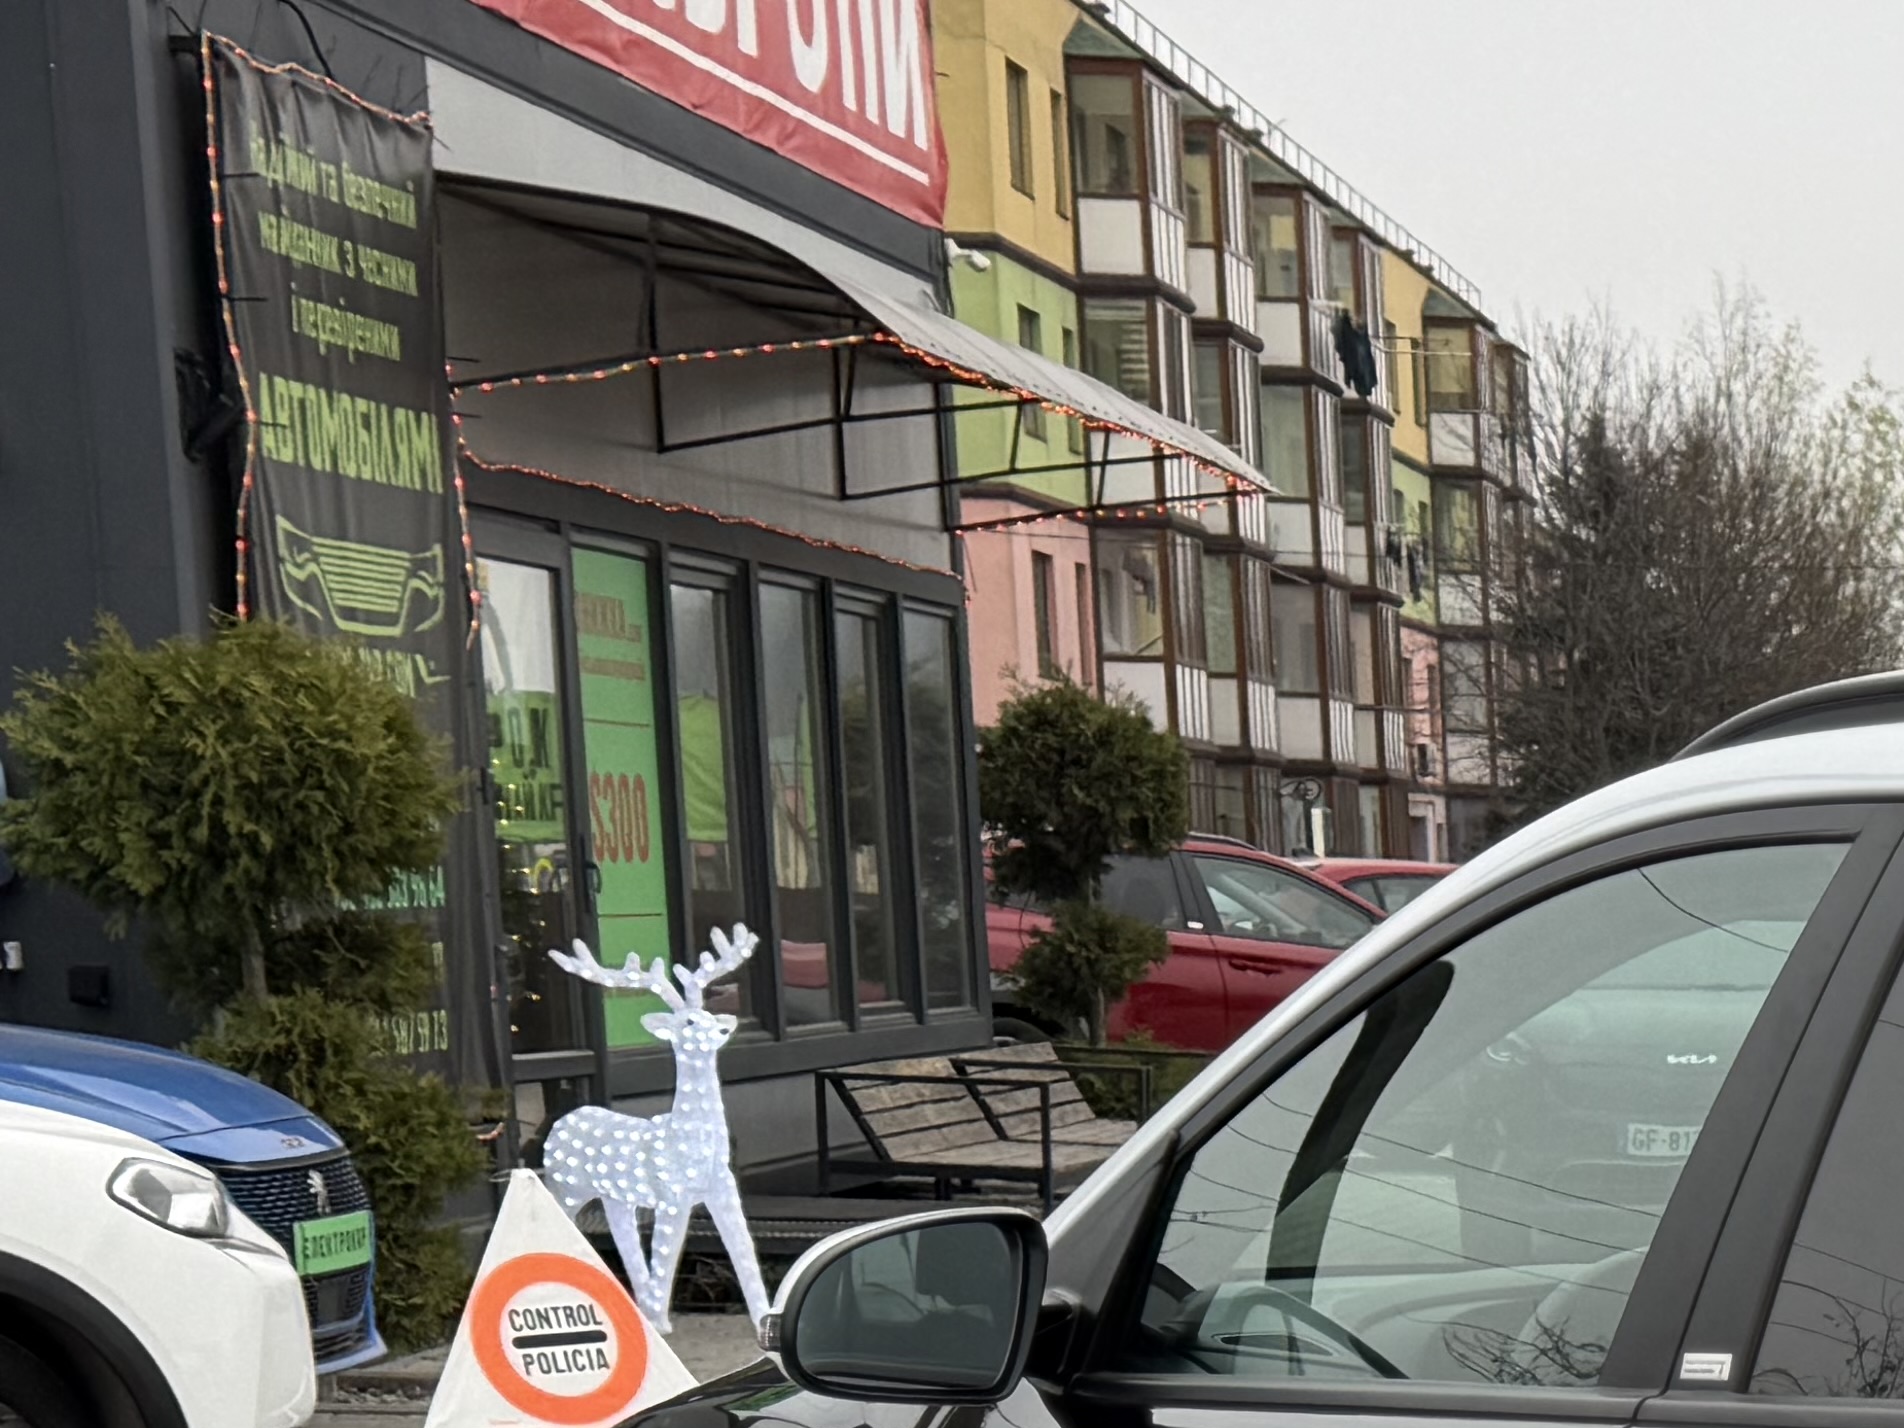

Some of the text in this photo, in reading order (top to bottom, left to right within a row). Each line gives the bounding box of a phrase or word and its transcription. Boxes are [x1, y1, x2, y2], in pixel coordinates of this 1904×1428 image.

[1631, 1127, 1699, 1153] GF-81
[508, 1303, 603, 1332] CONTROL
[521, 1347, 610, 1377] POLICIA
